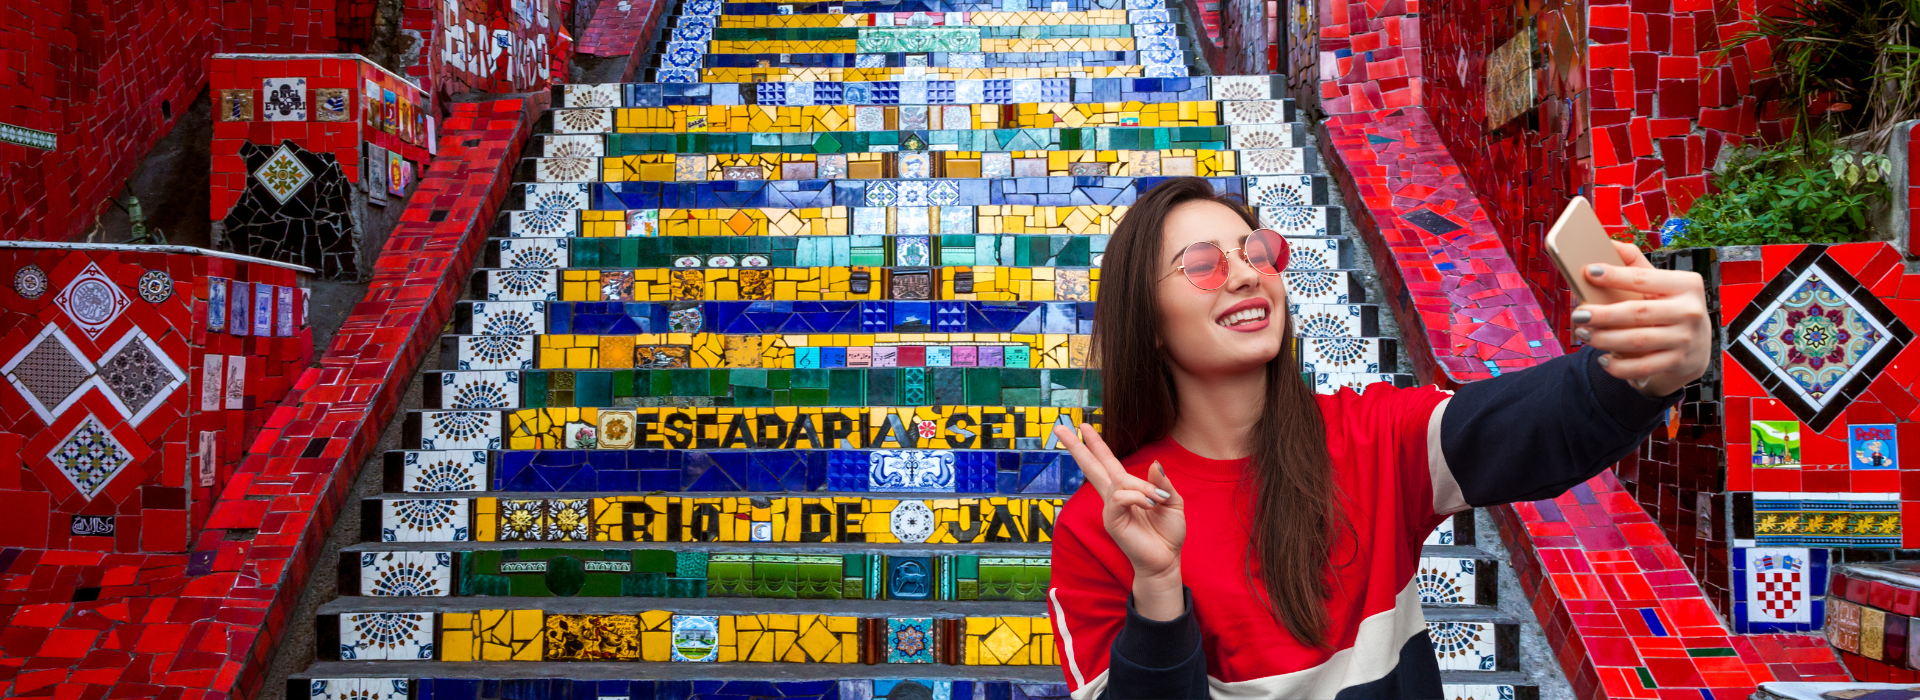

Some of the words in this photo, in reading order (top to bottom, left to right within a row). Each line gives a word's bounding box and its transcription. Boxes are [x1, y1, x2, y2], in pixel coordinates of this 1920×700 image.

[271, 90, 299, 98] ONGI
[265, 102, 306, 110] ETORRI
[637, 412, 912, 449] ESCADARIA
[1855, 427, 1893, 441] POPEYE
[622, 502, 719, 542] RIO
[801, 503, 866, 543] DE
